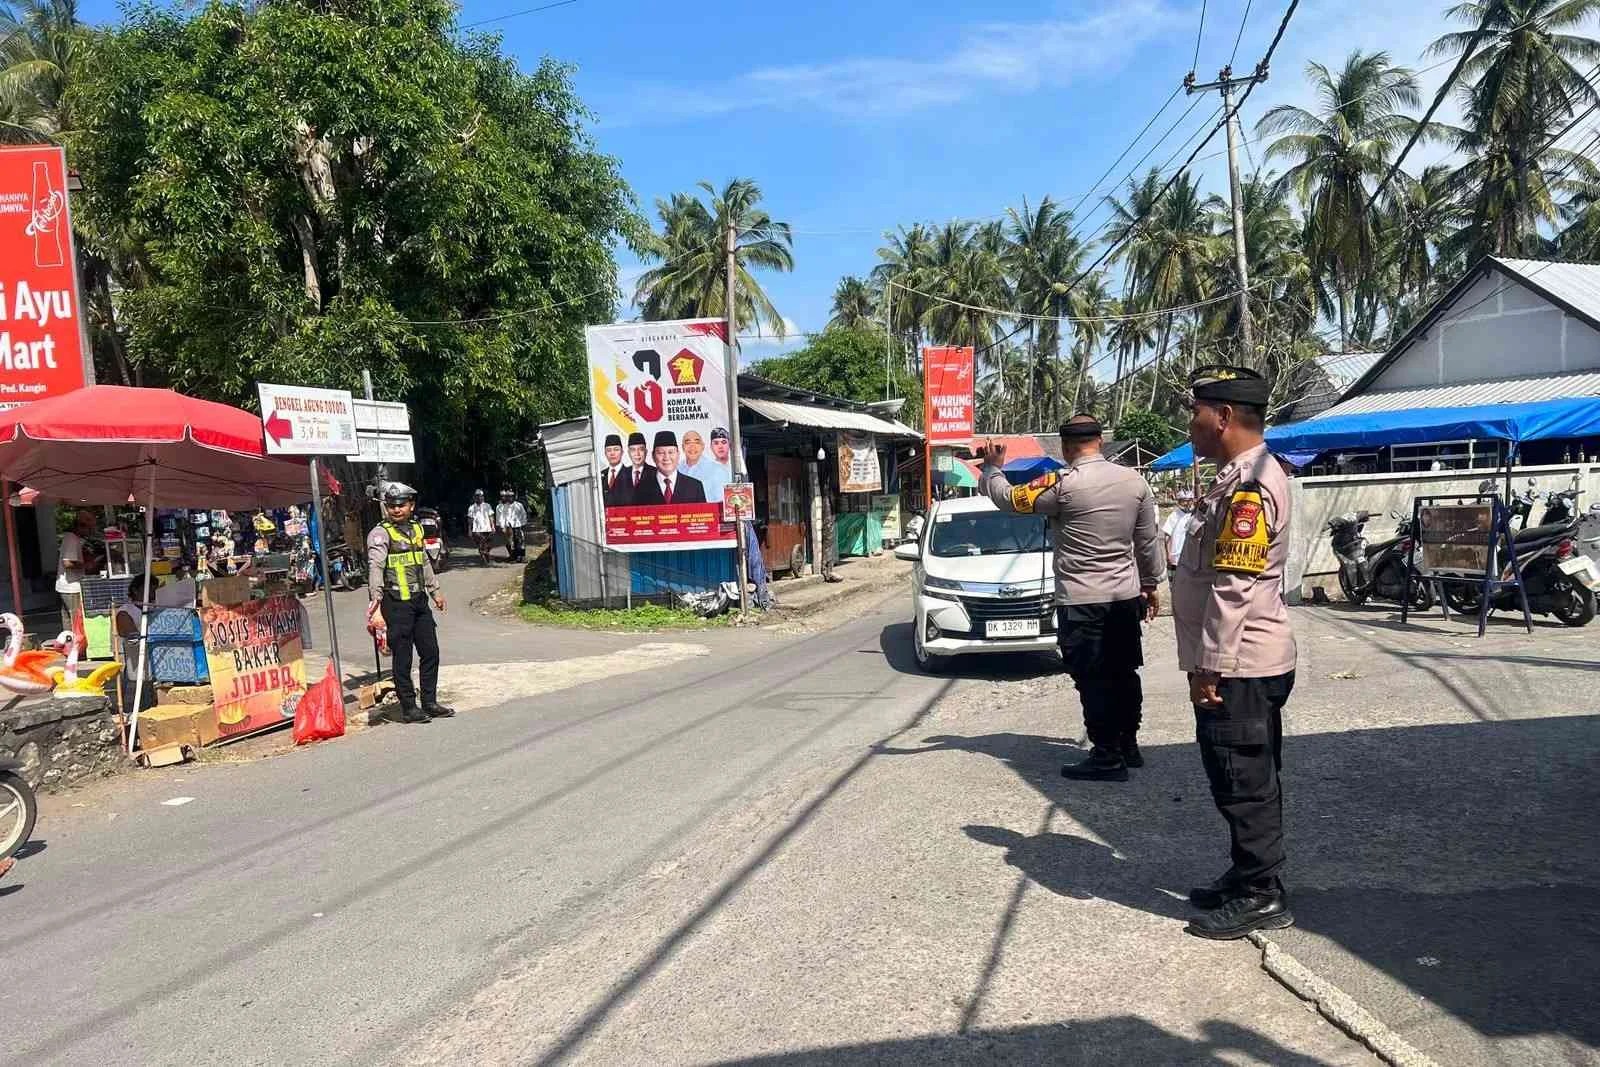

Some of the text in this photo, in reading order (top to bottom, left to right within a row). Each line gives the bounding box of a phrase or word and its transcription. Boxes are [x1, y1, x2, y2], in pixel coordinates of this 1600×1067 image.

[14, 280, 72, 328] Ayu
[666, 386, 708, 394] GERINDRA
[666, 398, 696, 406] KOMPAK
[931, 394, 972, 407] WARUNG
[324, 400, 347, 415] TOYOTA
[667, 405, 702, 414] BERGERAK
[938, 406, 965, 419] MADE
[667, 413, 709, 421] BERDAMPAK
[209, 616, 249, 647] SOSIS
[257, 608, 298, 639] AYAM
[988, 622, 998, 632] DK
[233, 642, 282, 673] BAKAR
[231, 666, 295, 699] JUMBO
